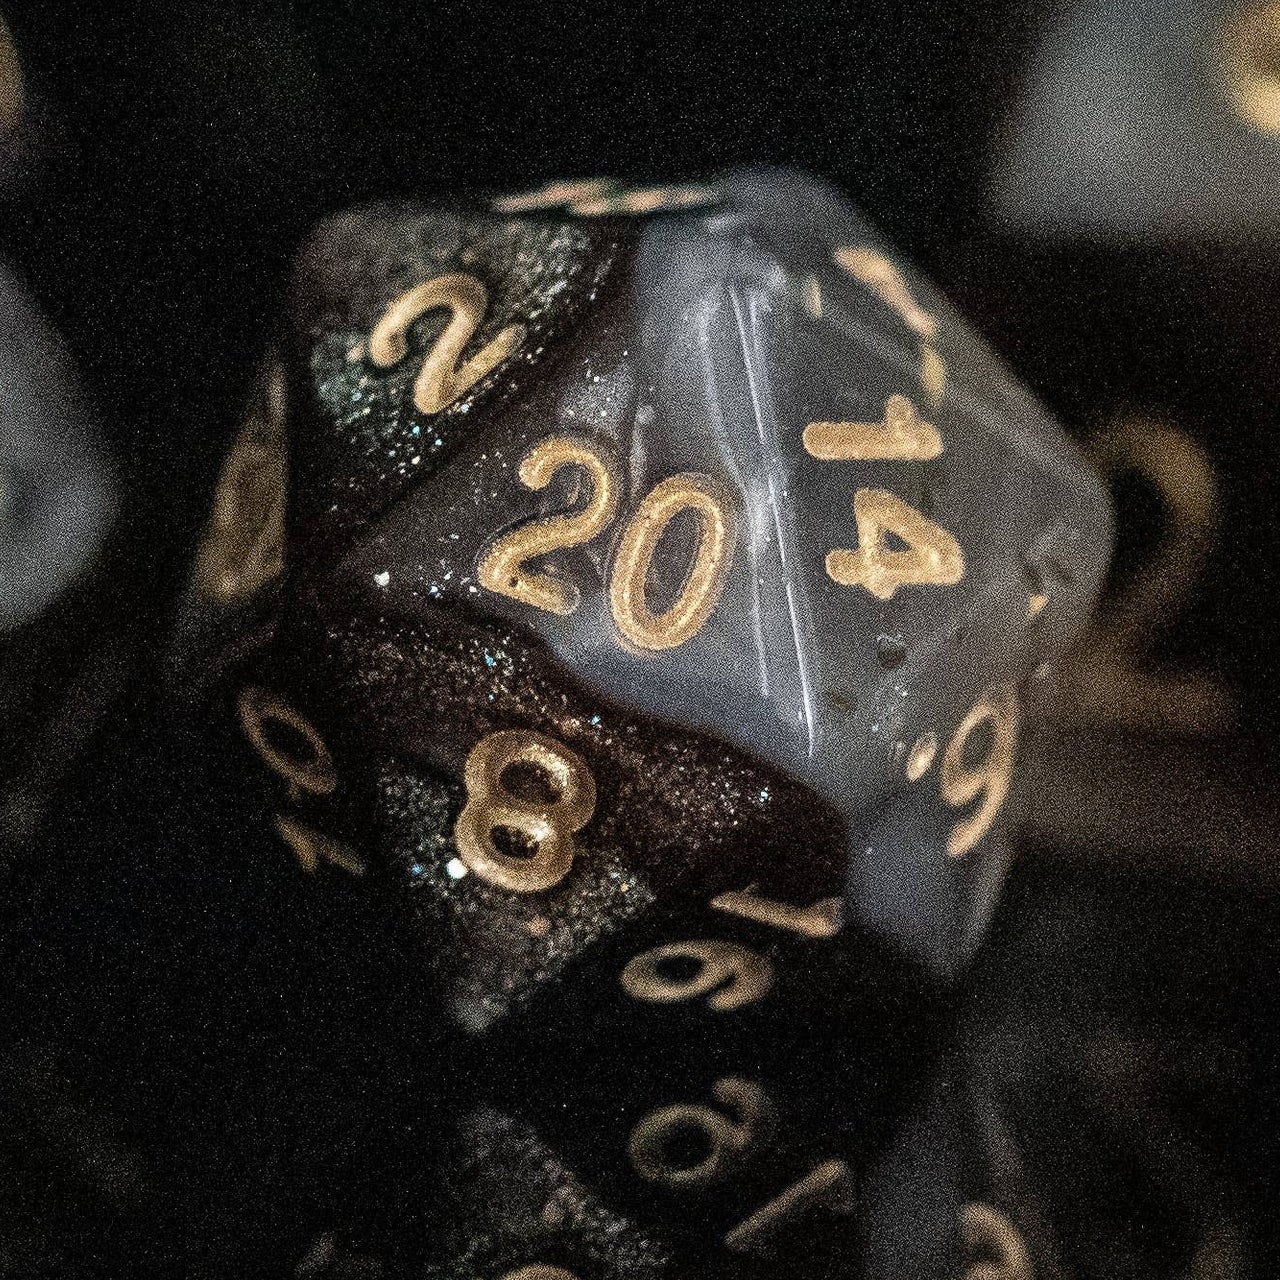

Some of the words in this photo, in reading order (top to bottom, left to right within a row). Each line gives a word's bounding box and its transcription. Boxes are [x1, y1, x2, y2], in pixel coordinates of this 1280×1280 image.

[367, 273, 525, 415] 2
[477, 434, 734, 654] 20
[803, 395, 965, 599] 14
[453, 728, 596, 891] 8
